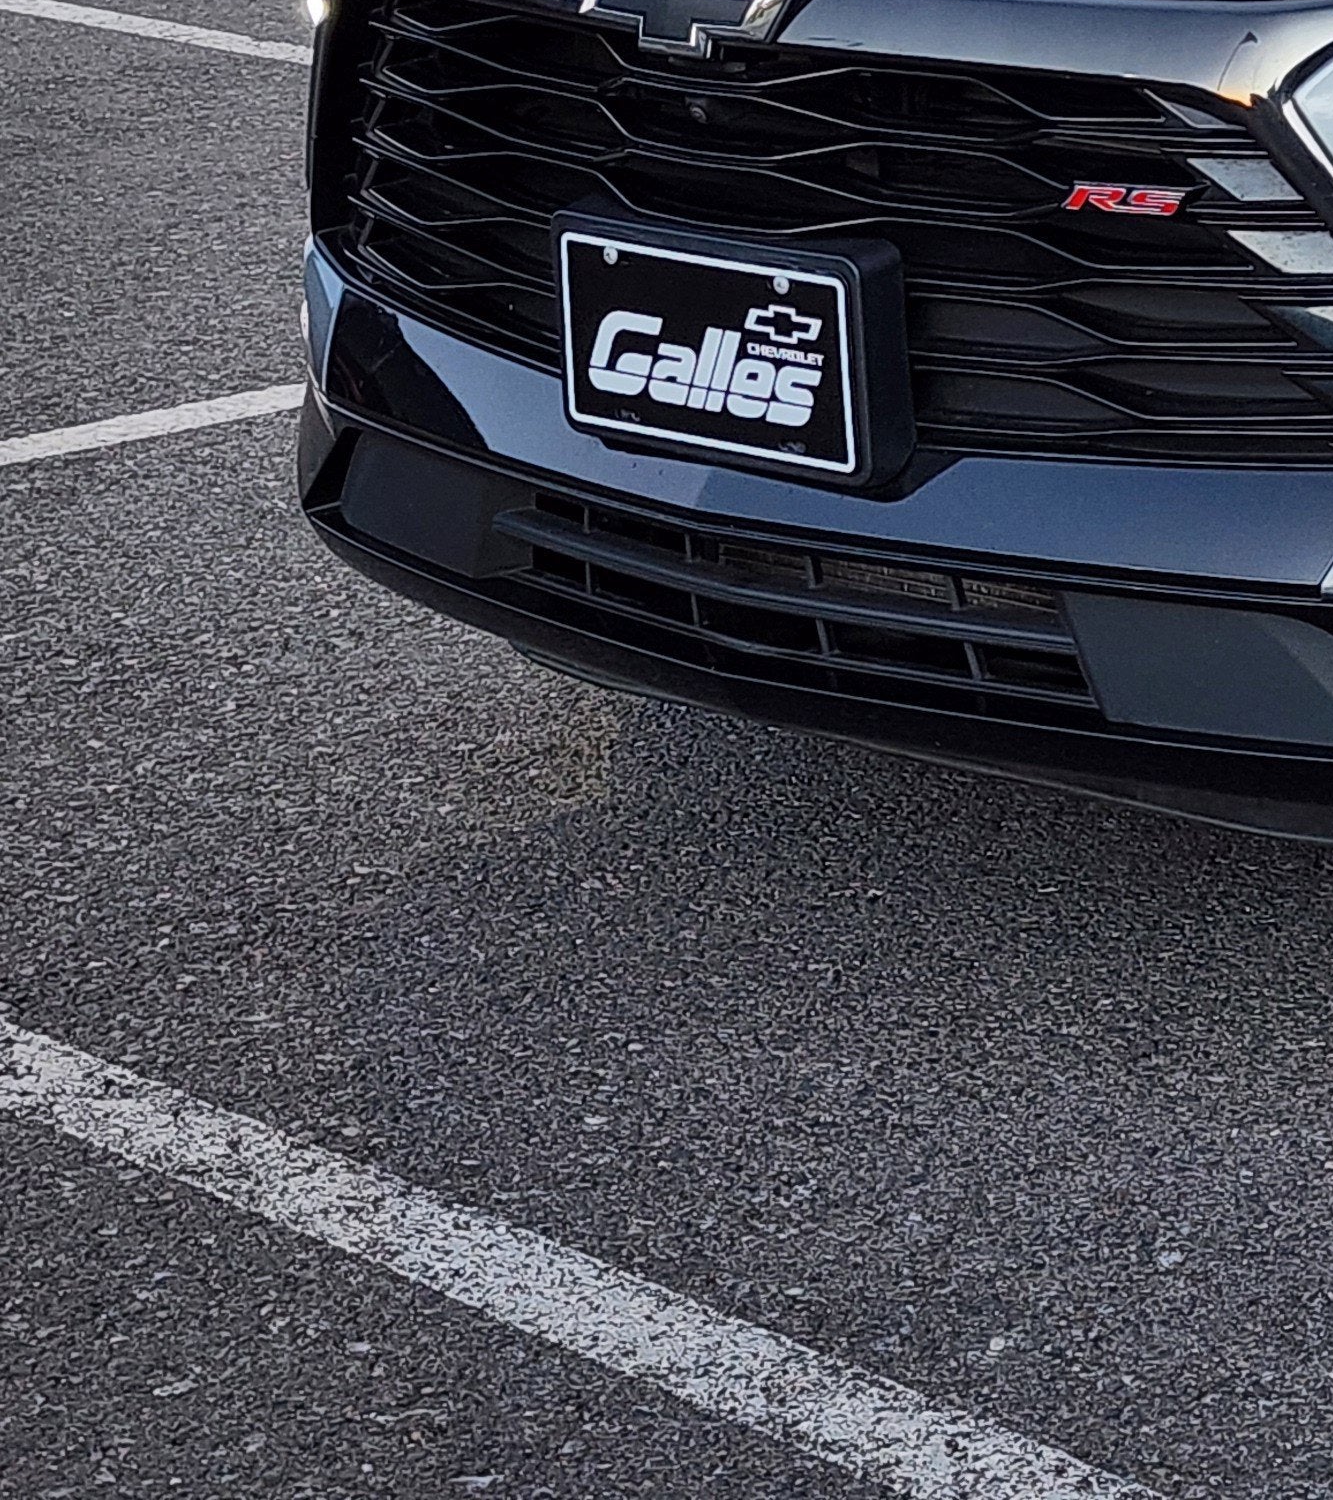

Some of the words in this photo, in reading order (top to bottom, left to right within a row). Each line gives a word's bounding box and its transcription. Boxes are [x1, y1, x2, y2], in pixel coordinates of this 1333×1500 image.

[1061, 184, 1185, 216] RS
[588, 310, 822, 427] Galles
[747, 342, 825, 367] CHEVROLET
